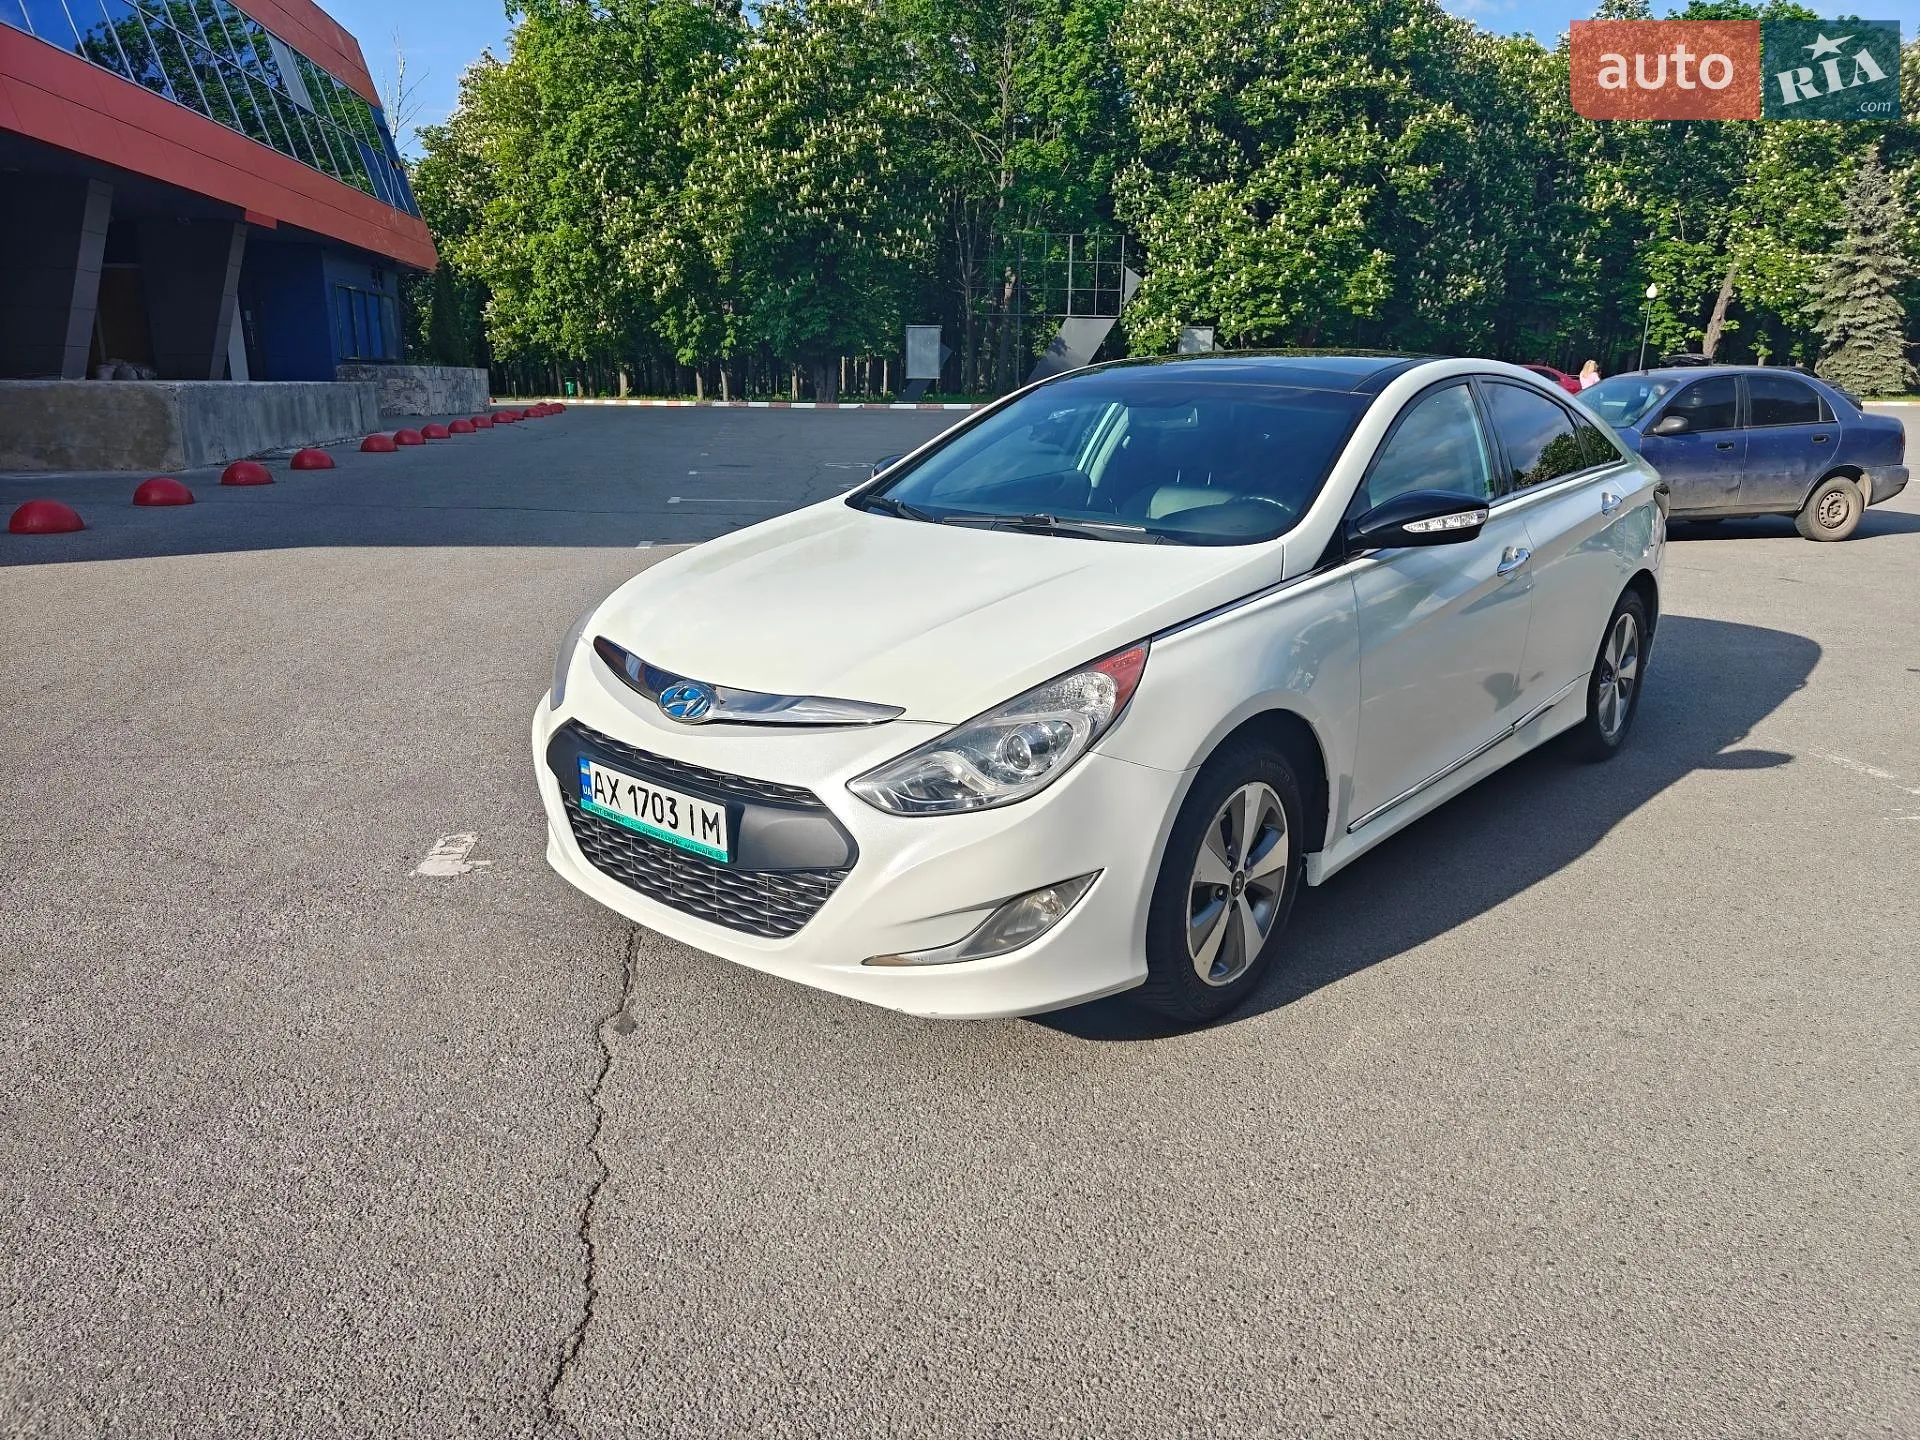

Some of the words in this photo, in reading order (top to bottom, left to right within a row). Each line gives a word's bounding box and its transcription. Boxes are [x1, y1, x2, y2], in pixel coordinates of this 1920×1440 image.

[582, 784, 593, 797] UA
[594, 770, 622, 810] AX
[627, 784, 679, 830] 1703
[689, 803, 721, 845] IM
